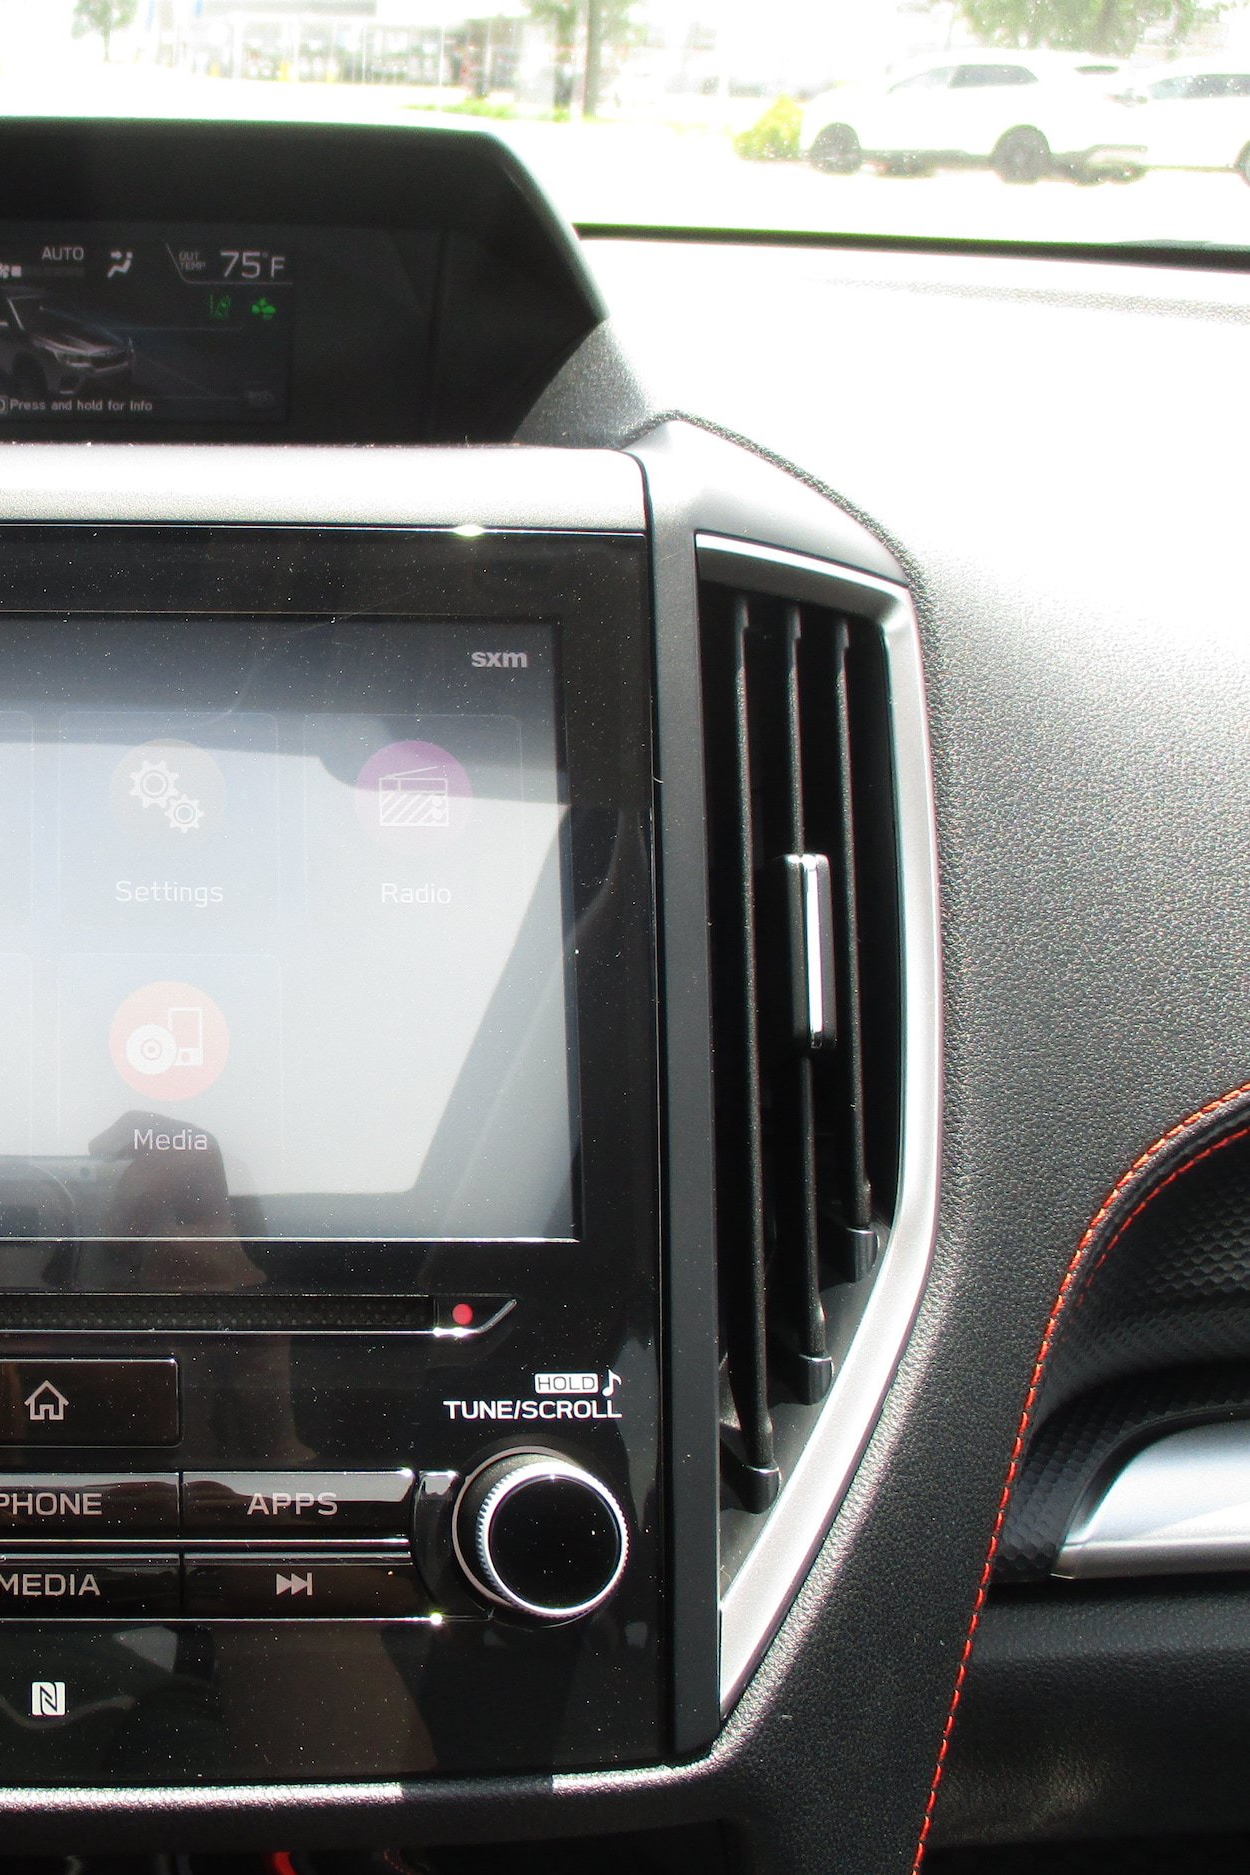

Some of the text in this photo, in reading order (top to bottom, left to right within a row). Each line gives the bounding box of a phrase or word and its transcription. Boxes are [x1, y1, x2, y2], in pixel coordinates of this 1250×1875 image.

[41, 247, 85, 261] AUTO
[10, 399, 47, 411] Press
[51, 399, 73, 411] and
[77, 400, 103, 412] hold
[107, 400, 125, 411] for
[471, 650, 527, 669] sxm
[114, 879, 224, 907] Settings
[380, 882, 451, 904] Radio
[133, 1128, 209, 1151] Media
[537, 1375, 597, 1392] HOLD
[443, 1399, 622, 1420] TUNE/SCROLL
[246, 1492, 338, 1516] APPS
